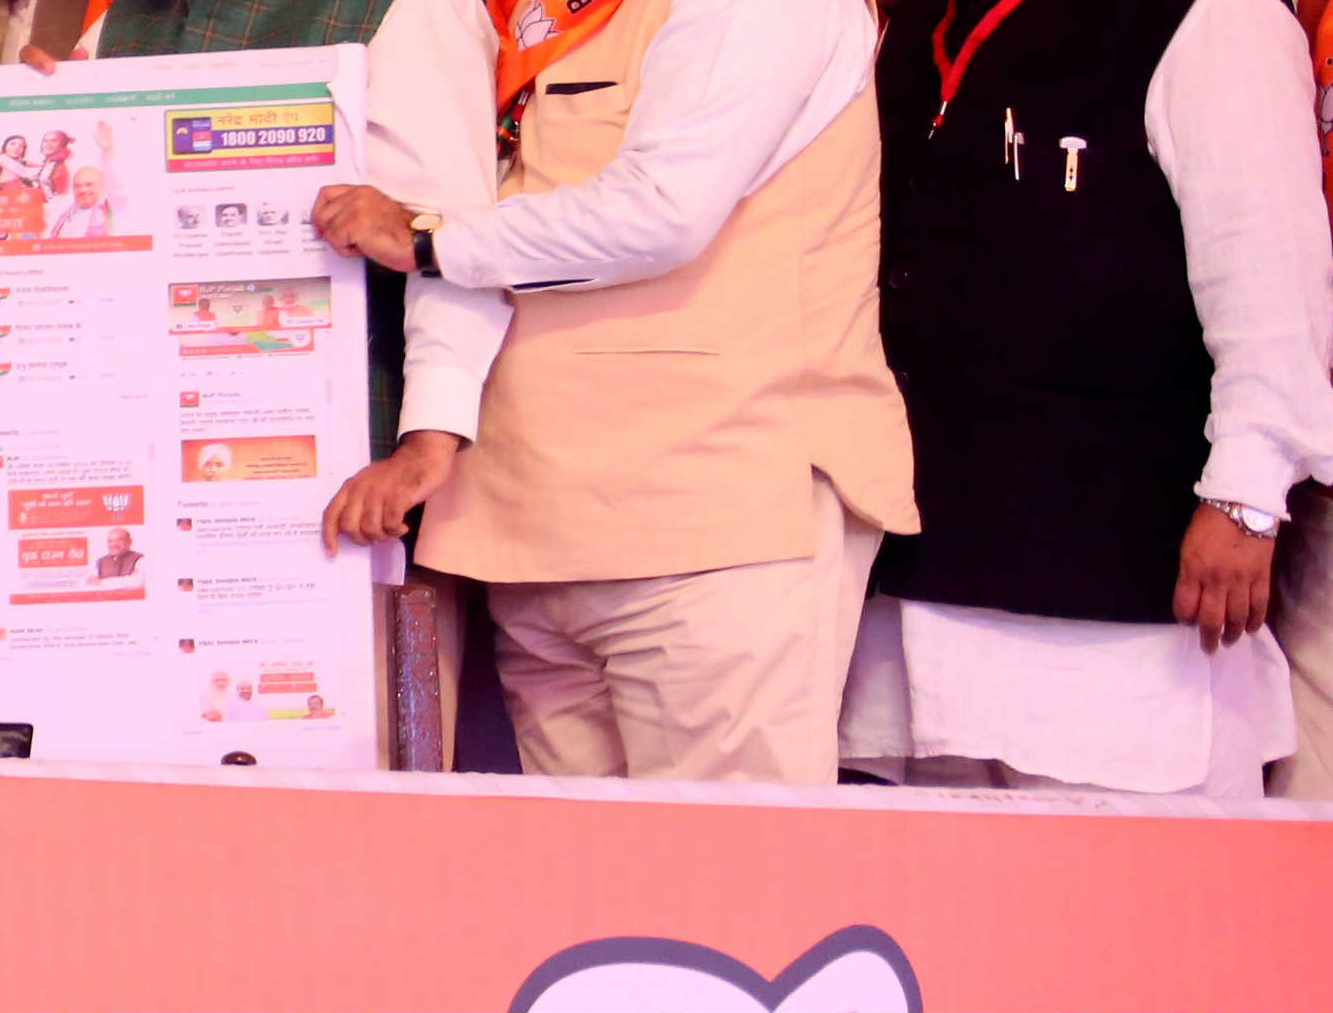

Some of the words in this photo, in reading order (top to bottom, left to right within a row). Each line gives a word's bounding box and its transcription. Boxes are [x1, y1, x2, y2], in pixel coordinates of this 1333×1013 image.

[221, 131, 256, 148] 1800
[257, 129, 296, 146] 2090
[298, 126, 326, 143] 920
